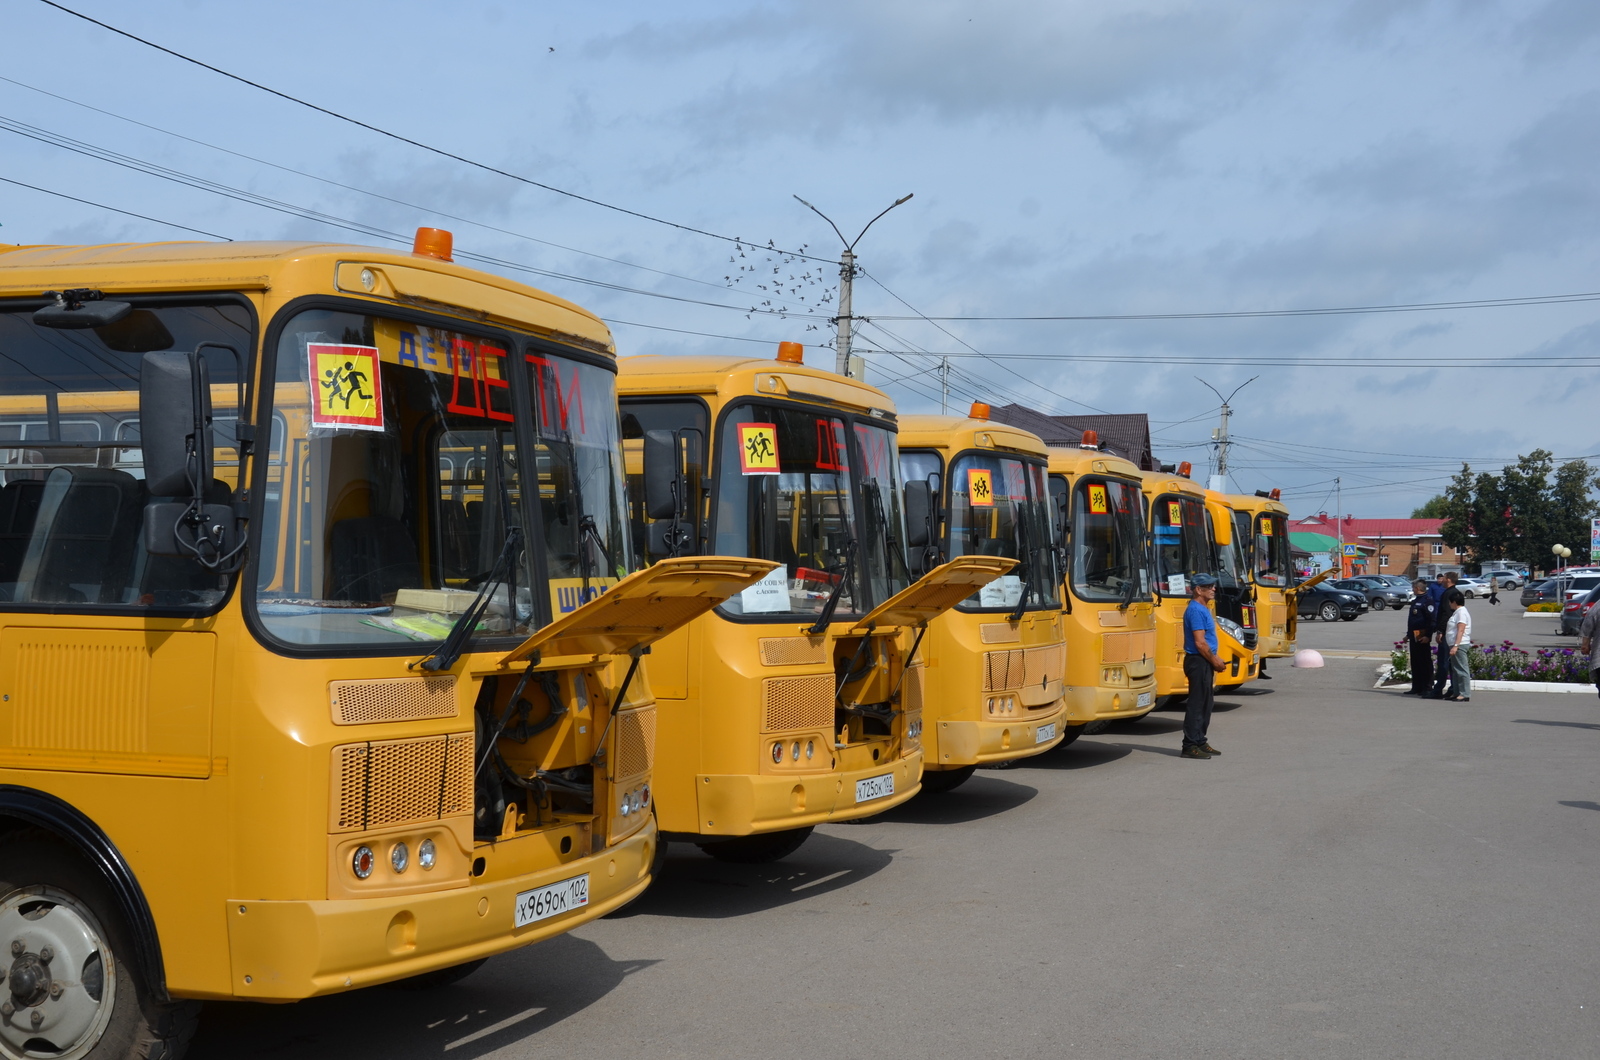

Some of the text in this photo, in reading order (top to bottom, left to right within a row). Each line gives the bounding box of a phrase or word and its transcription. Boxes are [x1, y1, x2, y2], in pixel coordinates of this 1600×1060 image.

[447, 338, 585, 434] ДЕТИ
[858, 780, 882, 800] Х725ОК
[520, 878, 586, 922] Х969ОК 102
